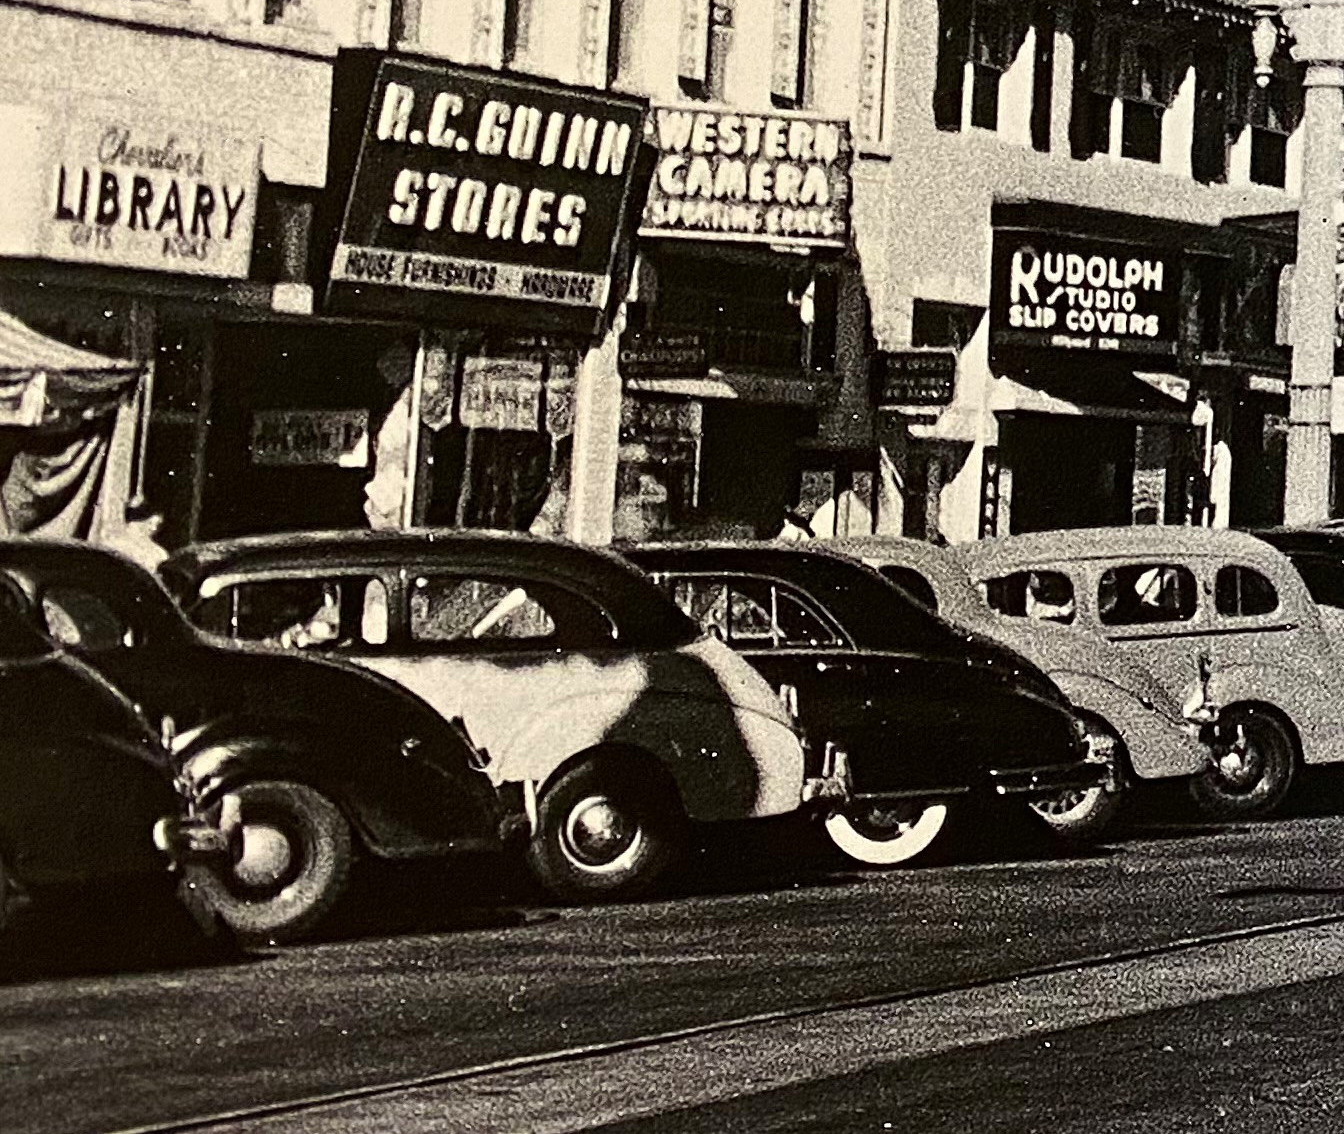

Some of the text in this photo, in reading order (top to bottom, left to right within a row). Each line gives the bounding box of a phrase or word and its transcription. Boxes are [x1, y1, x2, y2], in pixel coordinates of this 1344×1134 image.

[656, 108, 840, 165] WESTERN
[54, 165, 245, 240] LIBRARY
[658, 153, 830, 207] CAMERA
[388, 168, 587, 248] STORES
[345, 247, 395, 282] HOUSE
[1010, 245, 1164, 305] RUDOLPH
[1008, 304, 1159, 338] SLIP COVERS
[1045, 285, 1137, 312] STUDIO
